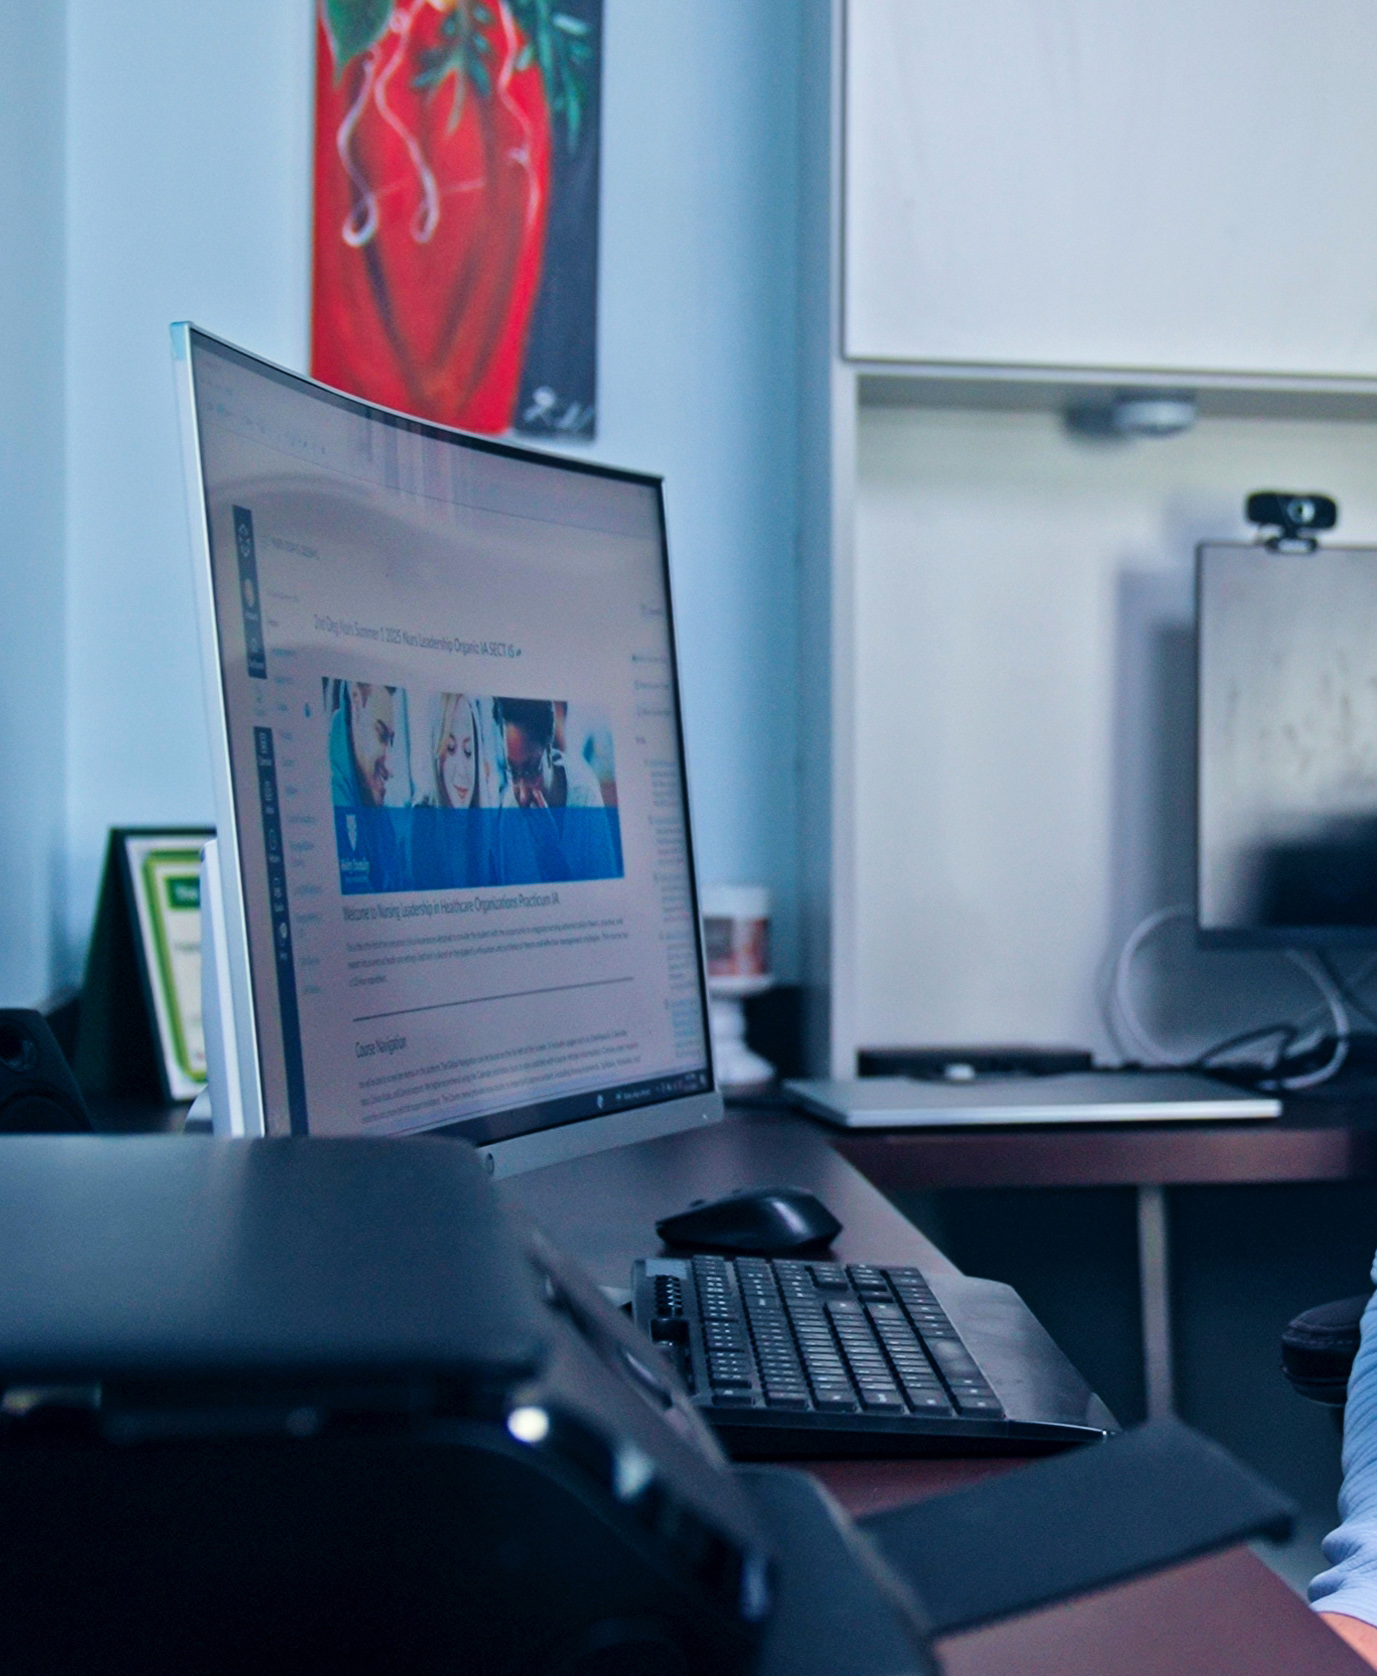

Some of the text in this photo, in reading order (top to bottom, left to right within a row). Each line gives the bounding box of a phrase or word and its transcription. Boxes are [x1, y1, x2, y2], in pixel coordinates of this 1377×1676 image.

[418, 633, 453, 655] Leadership
[342, 905, 370, 922] Welcome
[377, 903, 401, 921] Nursing
[401, 901, 432, 919] Leadership
[440, 898, 474, 914] Healthcare
[474, 895, 518, 914] Organizations
[518, 893, 551, 908] Practicum
